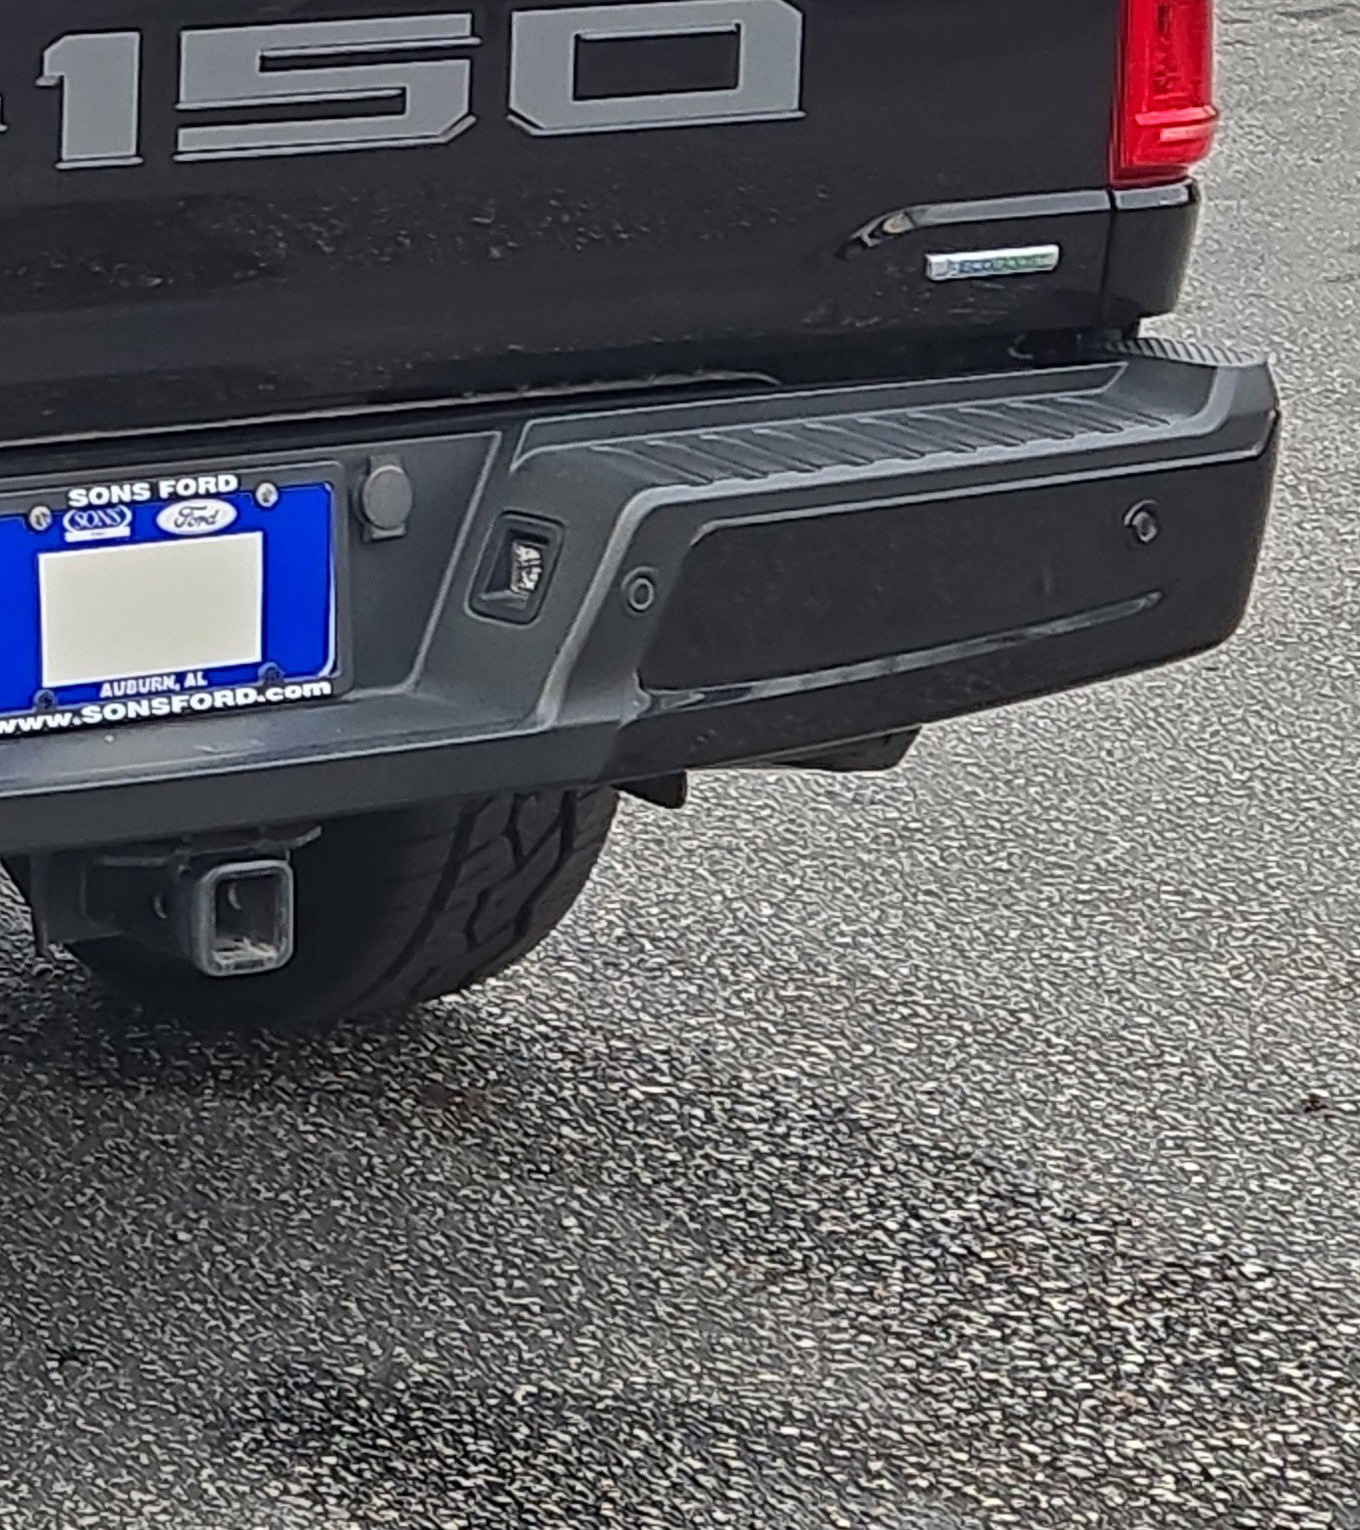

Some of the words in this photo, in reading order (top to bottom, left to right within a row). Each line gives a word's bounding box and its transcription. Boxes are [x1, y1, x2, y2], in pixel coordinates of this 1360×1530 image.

[67, 479, 151, 508] SONS
[158, 473, 239, 499] FORD
[173, 505, 221, 529] Ford
[99, 672, 180, 699] AUBURN,
[183, 671, 208, 688] AL
